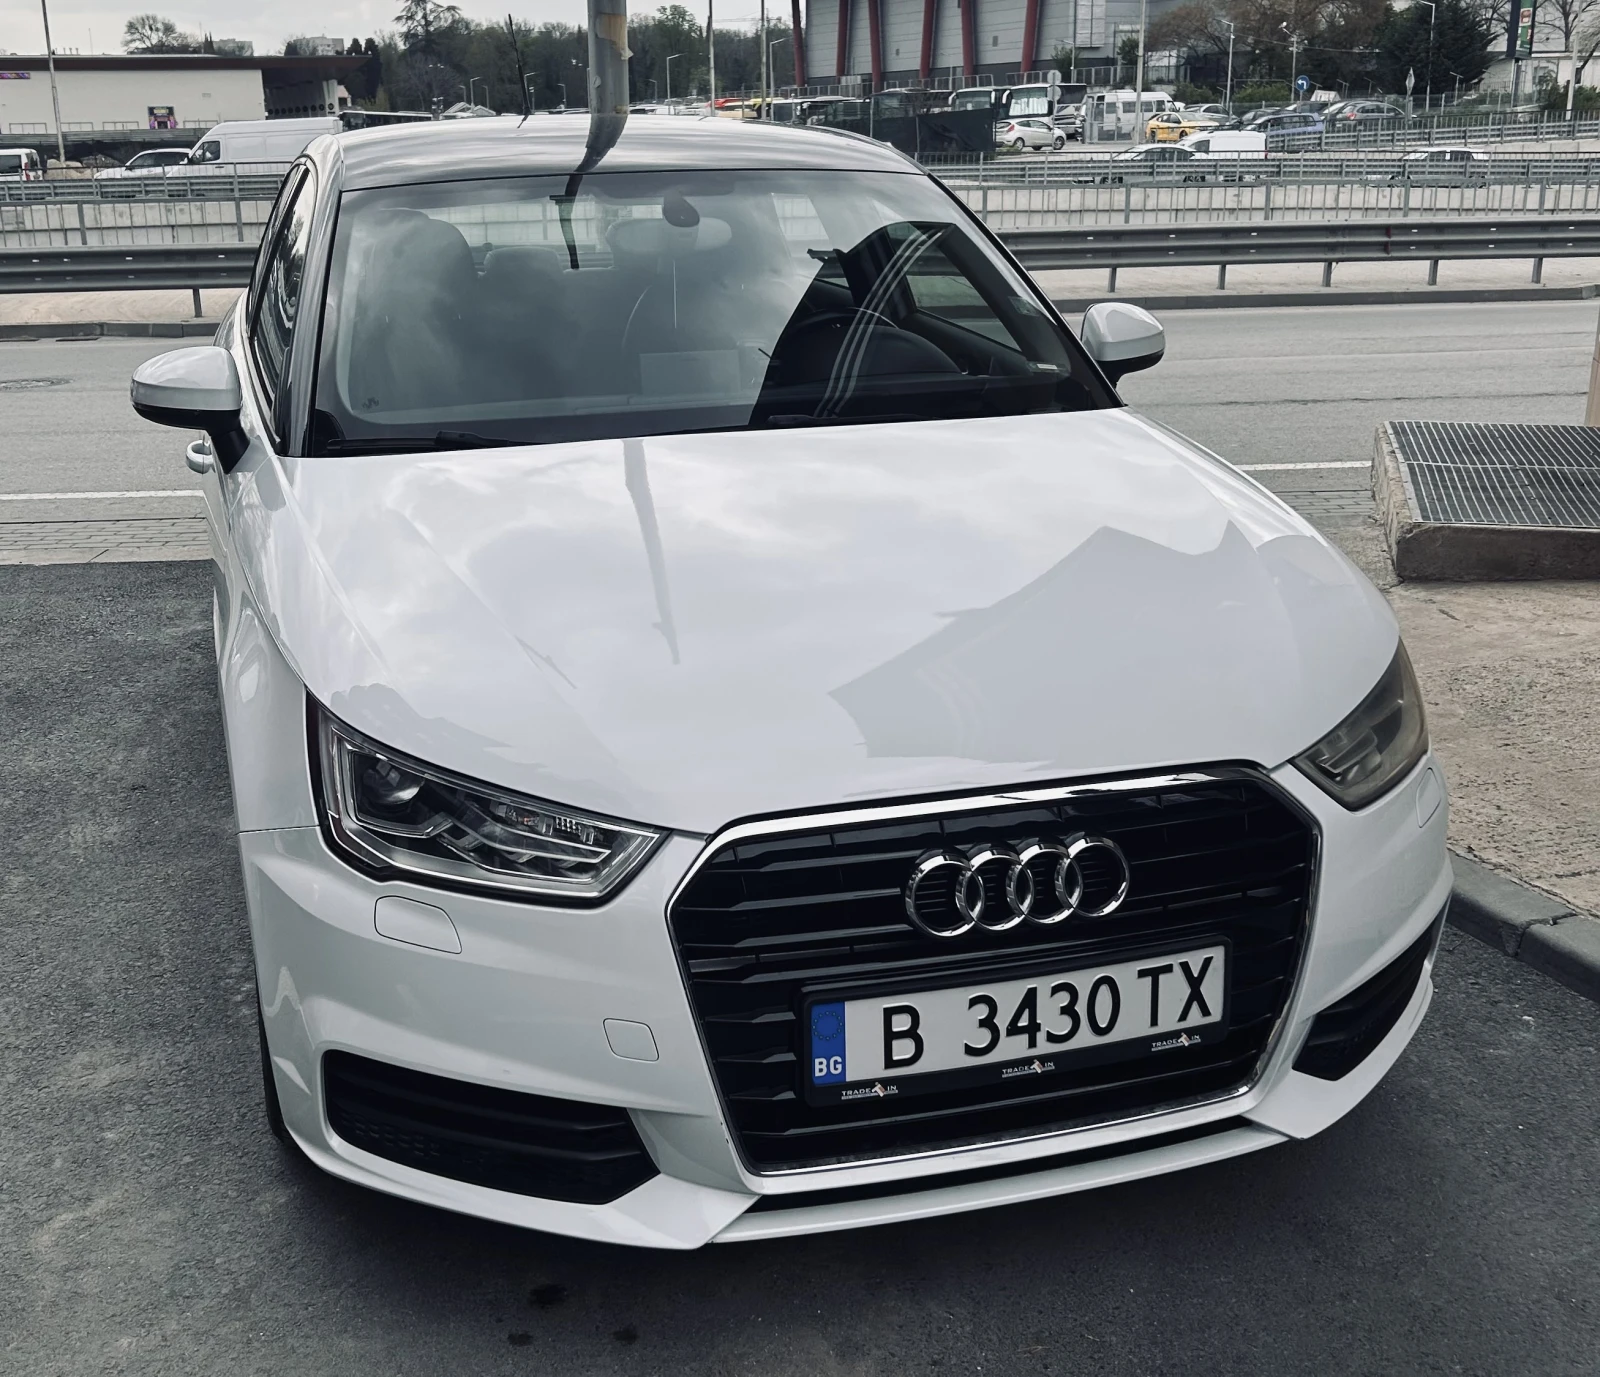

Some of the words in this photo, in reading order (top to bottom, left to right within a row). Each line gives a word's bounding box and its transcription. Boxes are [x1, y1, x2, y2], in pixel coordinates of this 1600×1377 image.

[883, 1004, 924, 1070] B
[964, 974, 1121, 1057] 3430
[1137, 955, 1214, 1028] TX
[1151, 1038, 1178, 1048] TRADE
[814, 1056, 843, 1077] BG
[1002, 1065, 1030, 1075] TRADE
[841, 1087, 871, 1096] TRADE
